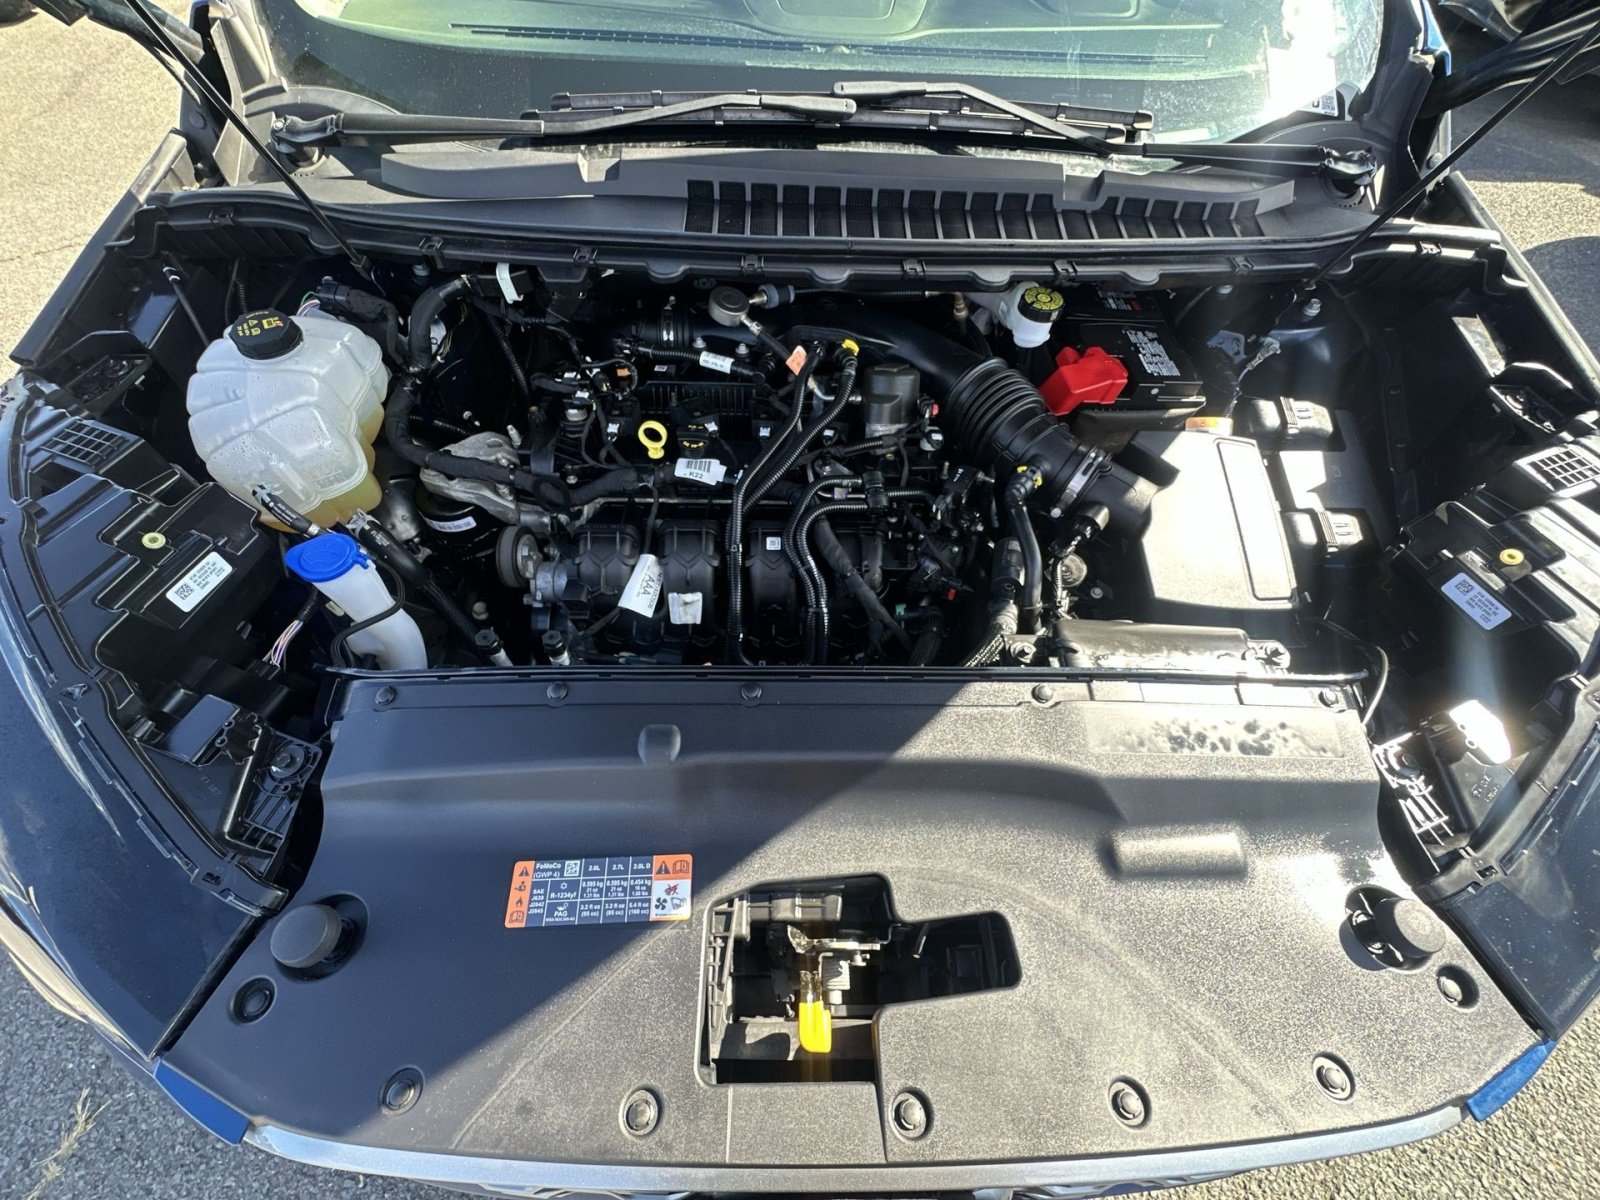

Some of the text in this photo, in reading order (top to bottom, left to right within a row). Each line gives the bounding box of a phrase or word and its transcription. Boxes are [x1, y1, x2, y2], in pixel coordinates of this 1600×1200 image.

[689, 471, 704, 479] K22
[640, 573, 655, 595] AAA
[596, 880, 604, 888] kg
[550, 892, 577, 900] R-1234yf
